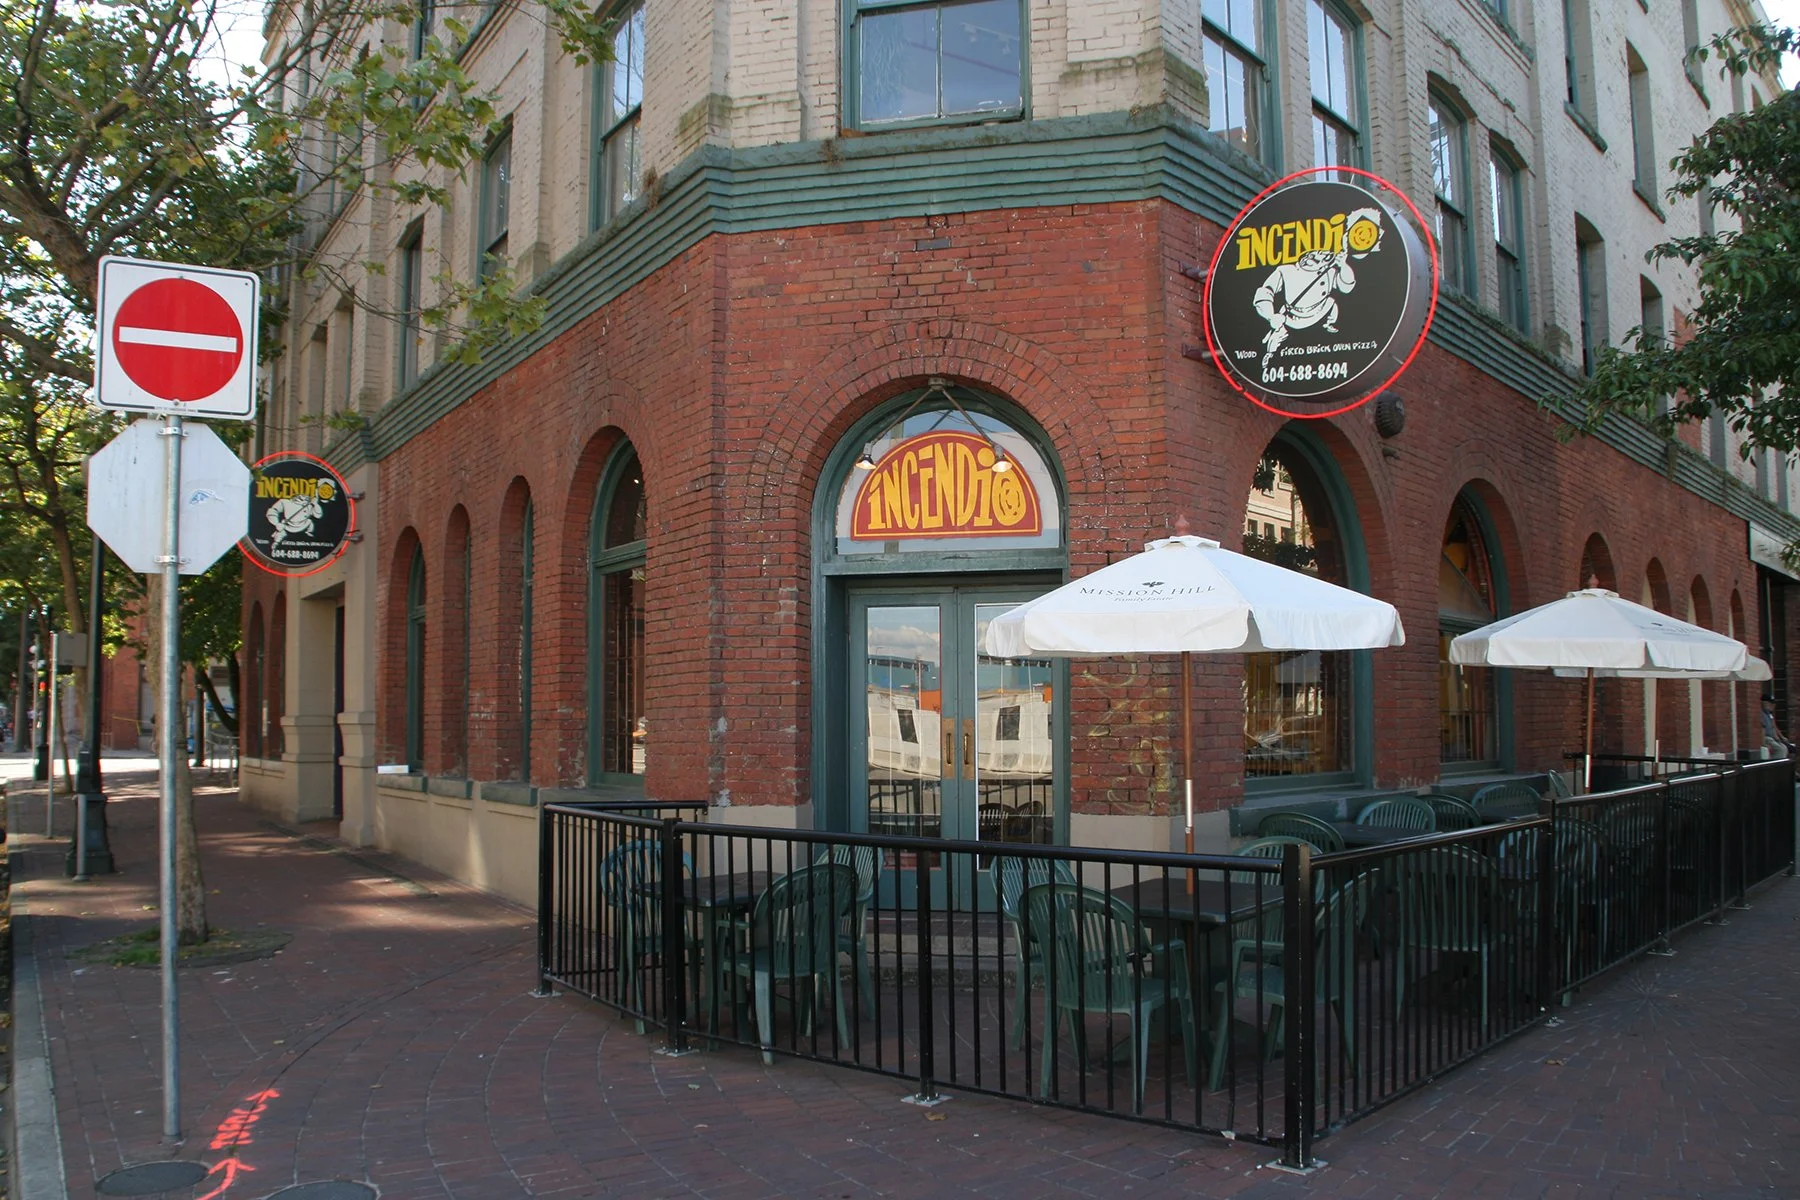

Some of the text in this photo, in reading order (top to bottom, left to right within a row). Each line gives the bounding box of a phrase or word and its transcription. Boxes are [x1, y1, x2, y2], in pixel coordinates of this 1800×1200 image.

[1262, 362, 1348, 383] 604-688-8694
[1080, 585, 1215, 596] MISSION HILL
